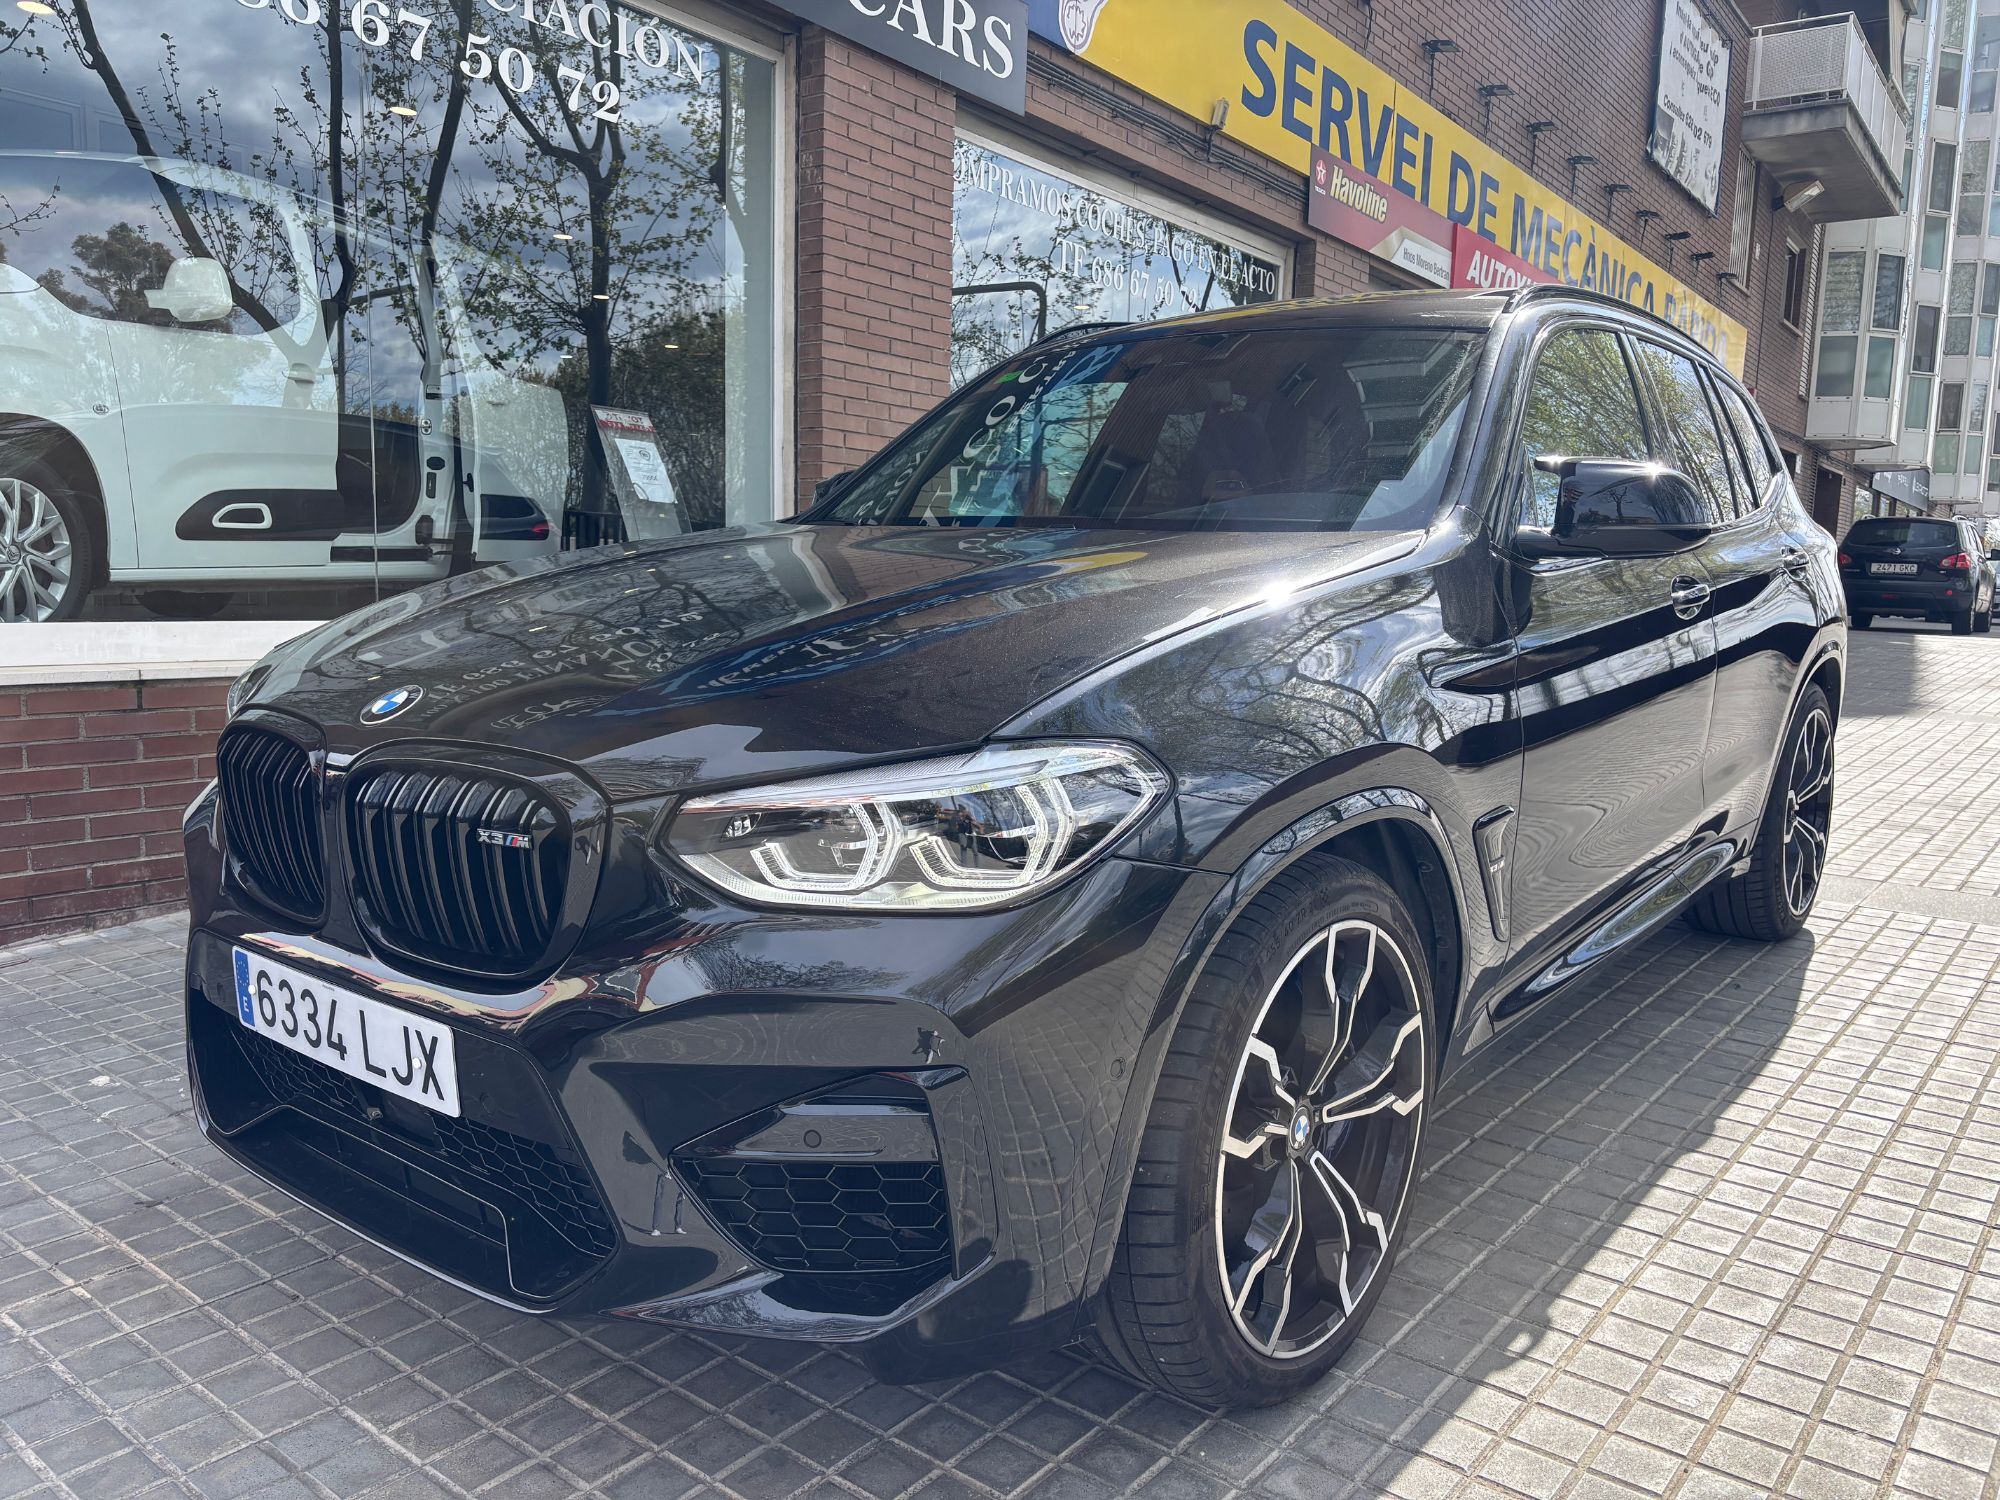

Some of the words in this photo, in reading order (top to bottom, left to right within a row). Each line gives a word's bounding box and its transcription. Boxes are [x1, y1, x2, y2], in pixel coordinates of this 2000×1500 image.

[351, 0, 432, 61] 67
[459, 32, 534, 93] 50
[557, 63, 622, 124] 72
[486, 0, 710, 85] IACIÓN
[850, 0, 1013, 79] ARS
[1241, 19, 1433, 208] SERVEI
[1447, 150, 1500, 240] DE
[1511, 192, 1654, 313] MECÀNICA
[1330, 164, 1388, 223] Havoline
[1055, 238, 1087, 278] TF
[1091, 256, 1125, 291] 686
[1130, 269, 1150, 300] 67
[1154, 275, 1174, 307] 50
[1153, 226, 1194, 265] PAGO
[1198, 244, 1218, 274] EN
[1221, 253, 1237, 283] EL
[1240, 260, 1275, 295] ACTO
[1416, 254, 1433, 274] Moreno
[1433, 262, 1450, 281] Bertran
[1899, 564, 1915, 572] GKC
[243, 996, 250, 1013] E
[256, 969, 347, 1061] 6334
[359, 1009, 445, 1101] LJX
